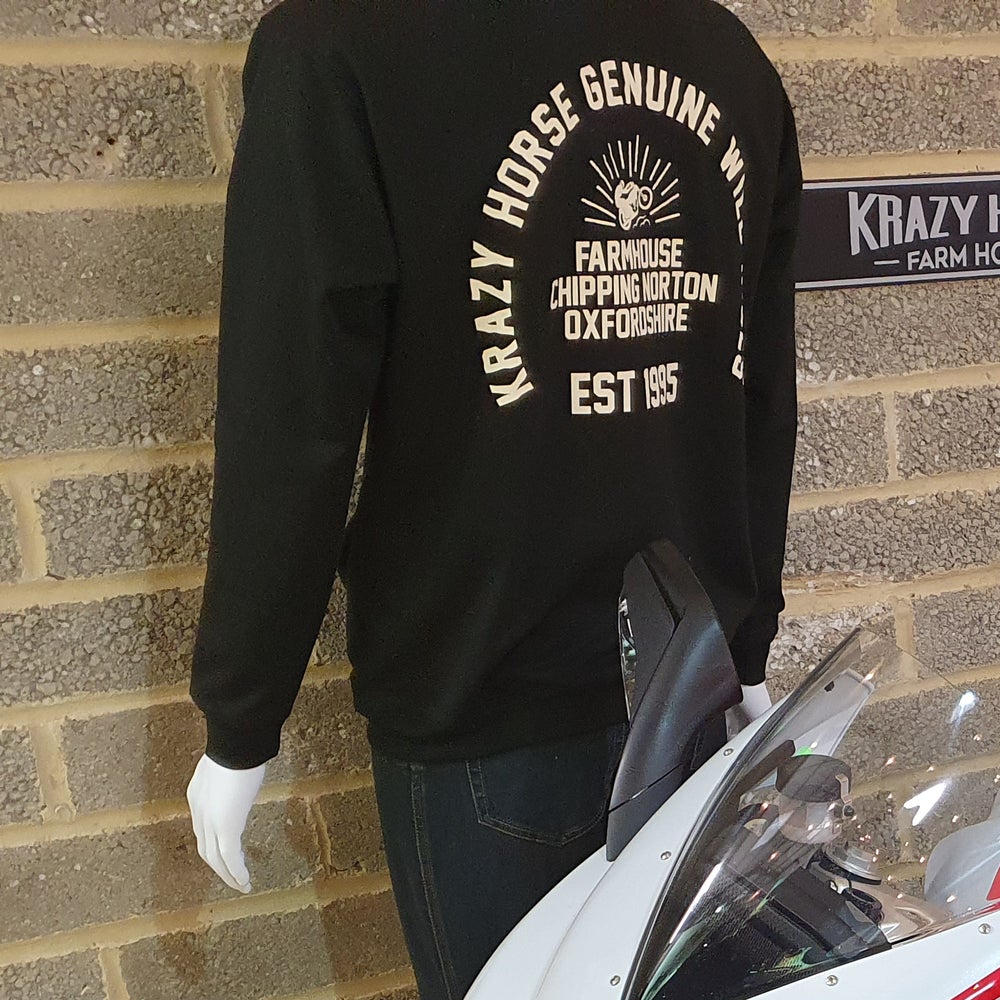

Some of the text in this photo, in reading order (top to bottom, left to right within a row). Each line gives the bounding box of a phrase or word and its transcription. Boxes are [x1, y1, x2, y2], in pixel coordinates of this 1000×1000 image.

[579, 59, 721, 146] GENUINE
[482, 82, 580, 229] HORSE
[848, 190, 979, 256] KRAZY
[575, 237, 684, 272] FARMHOUSE
[907, 243, 968, 271] FARM
[550, 270, 719, 310] CHIPPING NORTON
[469, 240, 535, 407] KRAZY
[564, 302, 690, 340] OXFORDSHIRE
[570, 362, 679, 415] EST 1995
